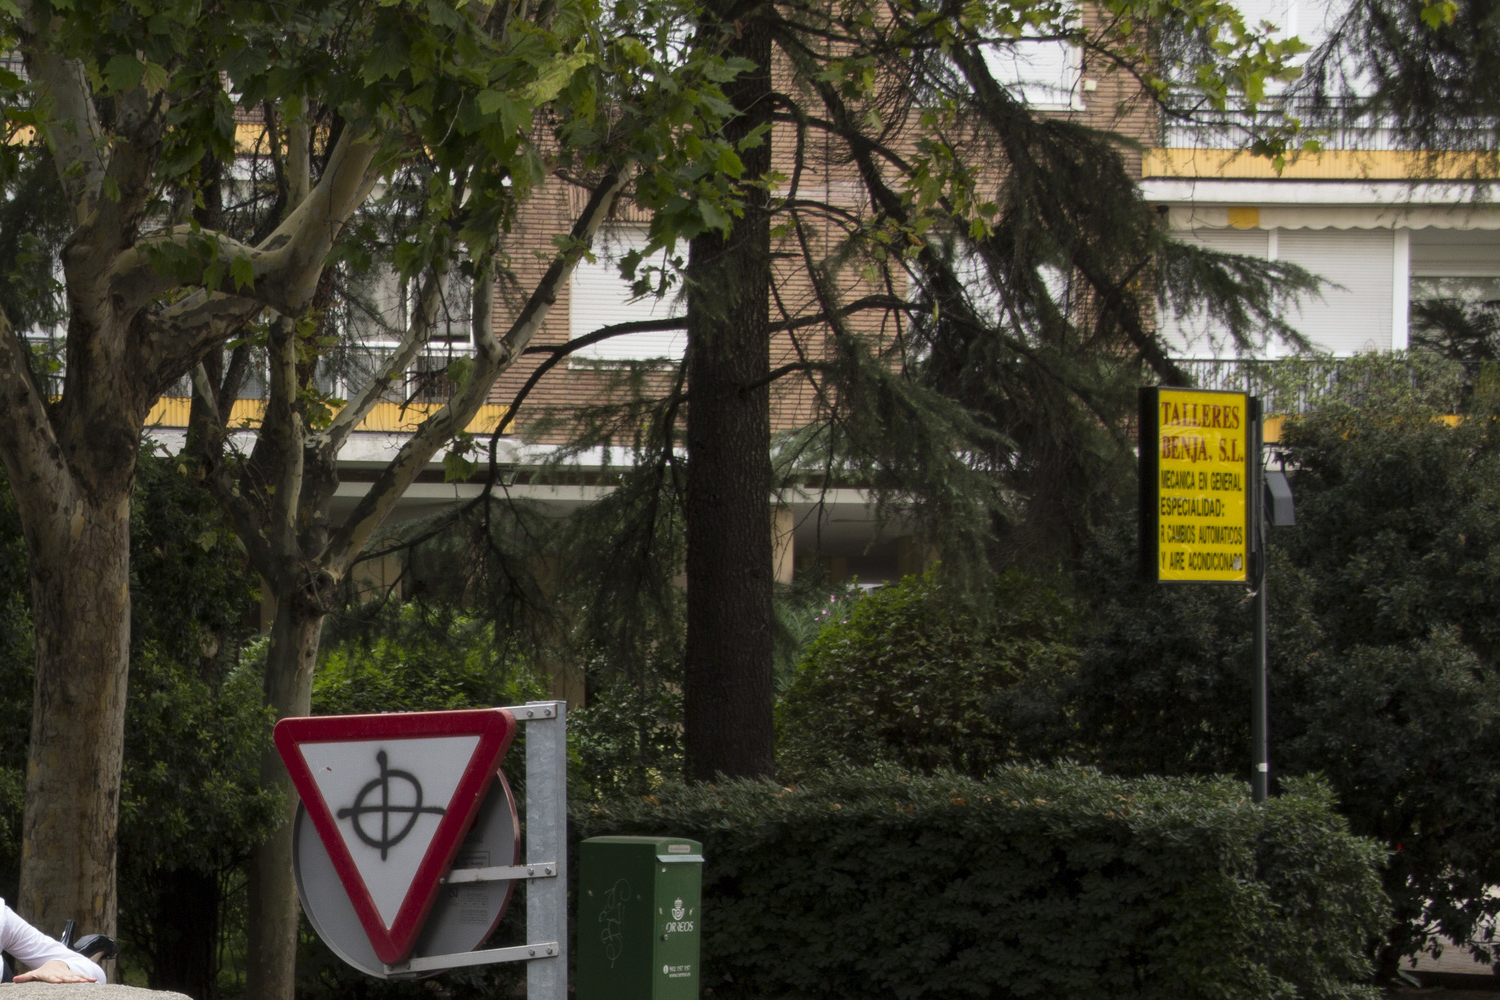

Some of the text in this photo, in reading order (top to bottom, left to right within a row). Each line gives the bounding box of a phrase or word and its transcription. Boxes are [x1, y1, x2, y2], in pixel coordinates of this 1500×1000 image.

[1161, 401, 1240, 430] TALLERES
[1162, 435, 1244, 463] BENJA, S.L.
[1161, 470, 1242, 492] MECANICA EN GENERAL
[1161, 497, 1225, 517] ESPECIALIDAD:
[1167, 525, 1195, 544] CAMBIOS
[1199, 526, 1243, 545] AUTOMATICOS
[1161, 552, 1166, 569] Y
[1169, 552, 1184, 570] AIRE
